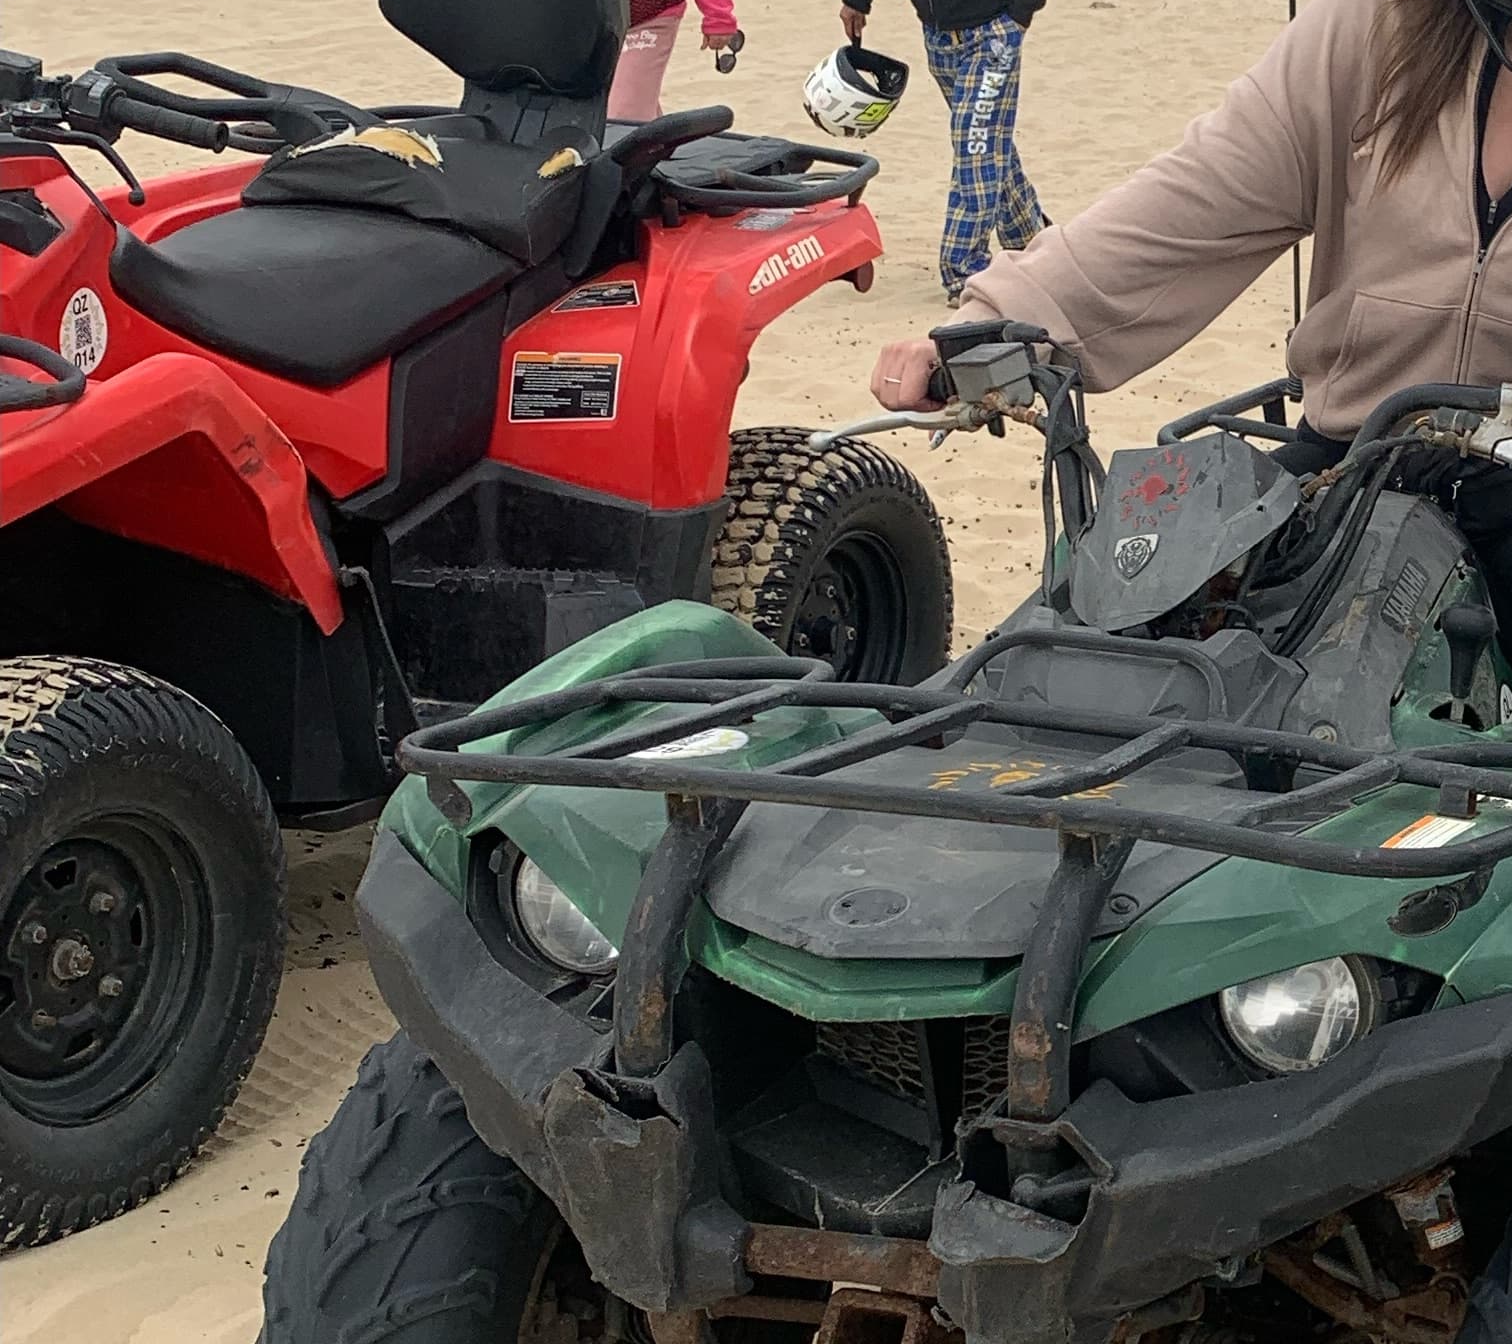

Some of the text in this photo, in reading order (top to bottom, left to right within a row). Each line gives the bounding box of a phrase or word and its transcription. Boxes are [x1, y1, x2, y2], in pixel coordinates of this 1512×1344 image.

[968, 71, 1007, 155] EAGLES
[748, 235, 825, 295] can-am
[73, 294, 88, 315] QZ
[75, 347, 95, 368] 014
[1383, 562, 1427, 625] YAMAHA
